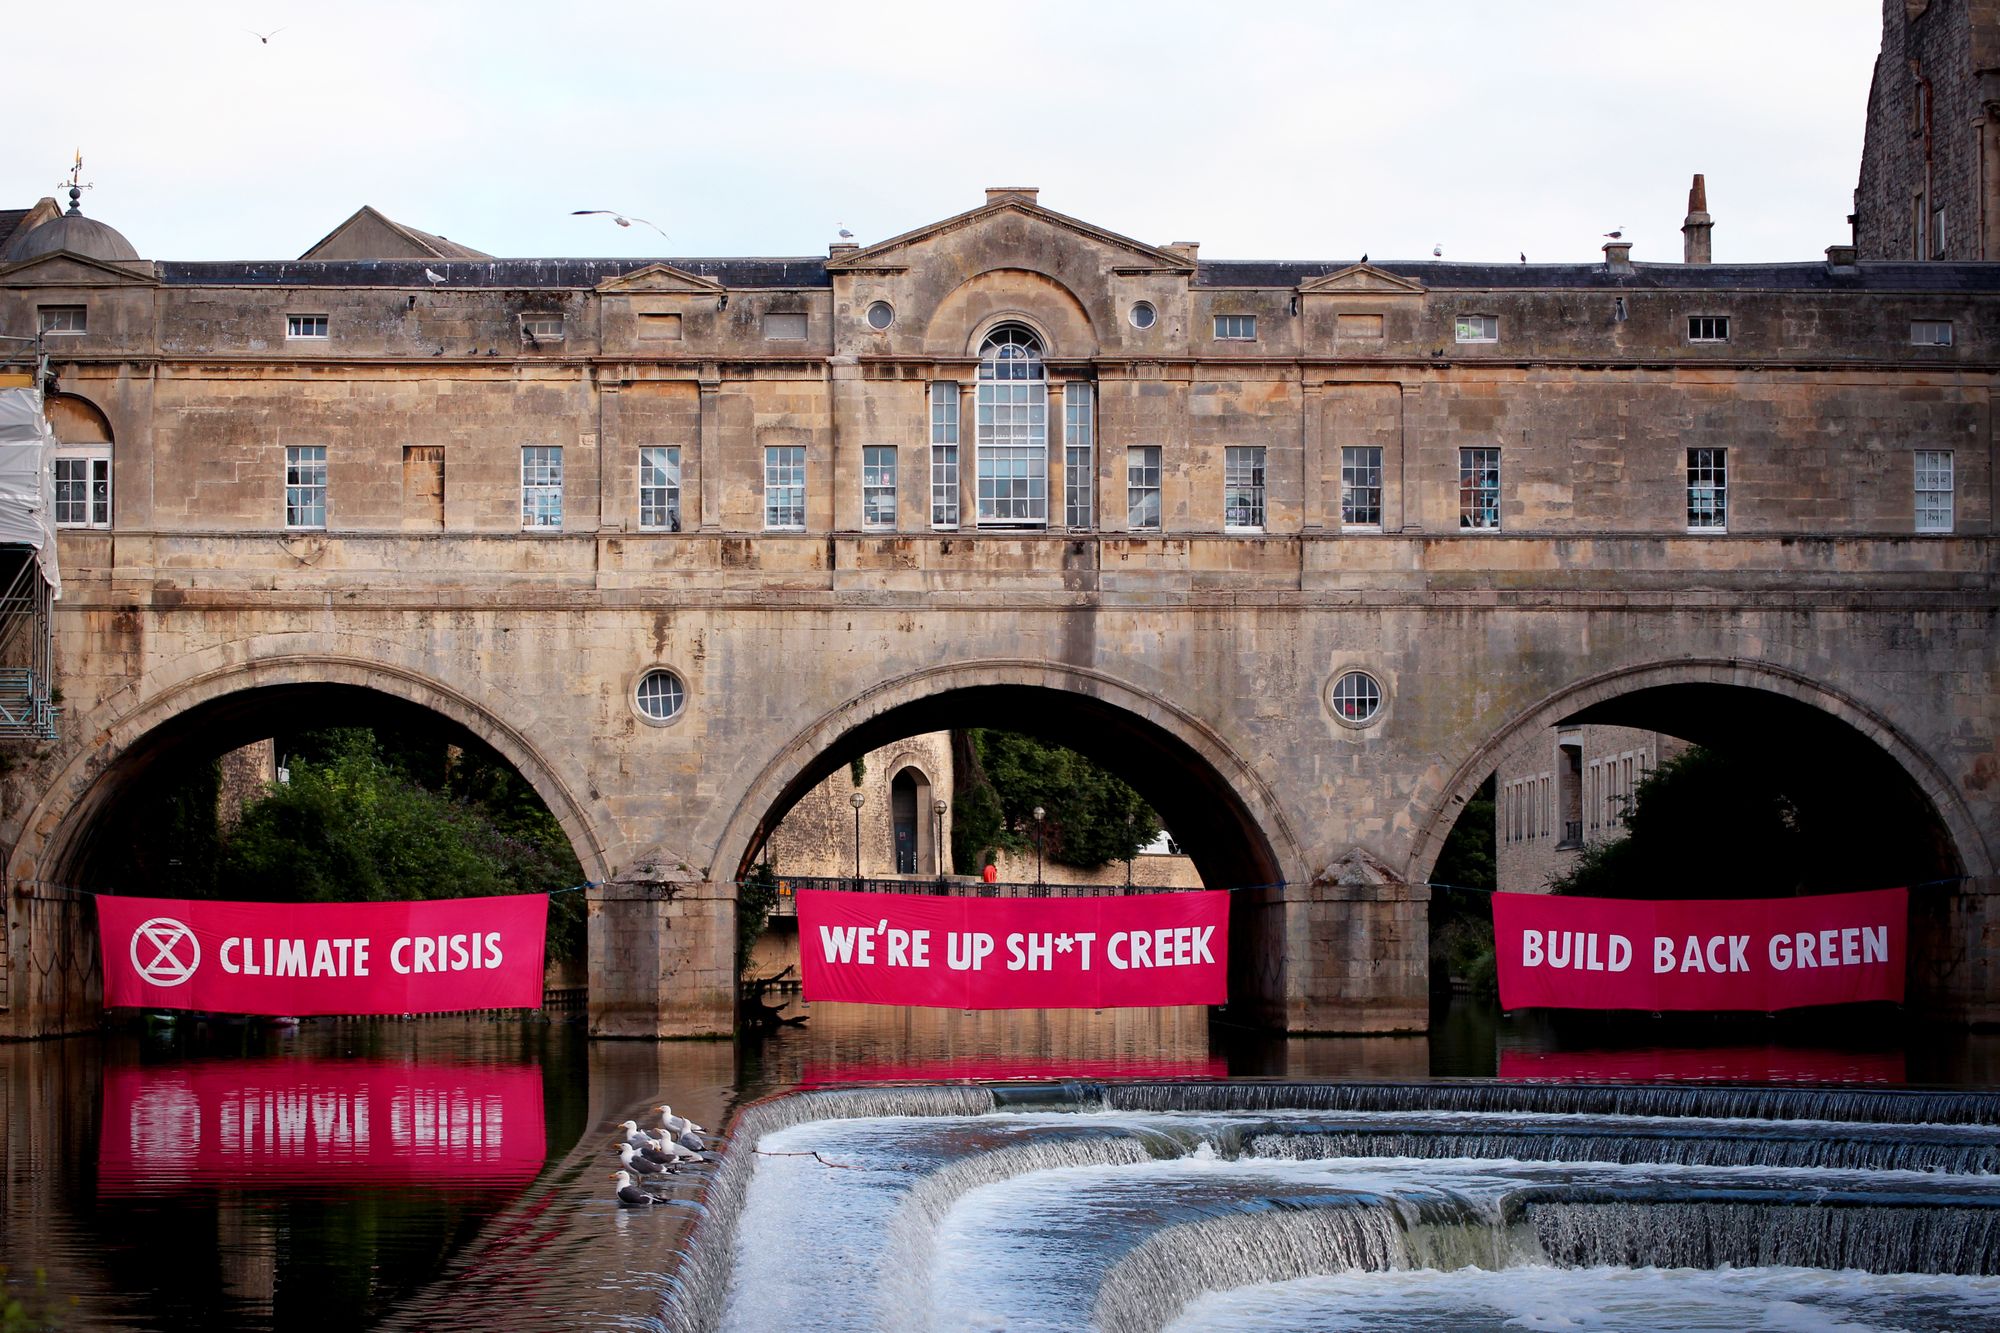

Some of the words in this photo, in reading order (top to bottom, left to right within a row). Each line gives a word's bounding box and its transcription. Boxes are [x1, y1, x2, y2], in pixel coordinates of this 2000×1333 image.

[1919, 475, 1947, 485] Atique
[220, 937, 369, 977] CLIMATE
[390, 932, 502, 974] CRISIS
[819, 919, 930, 967] WE'RE
[948, 932, 994, 970] UP
[1108, 926, 1215, 969] CREEK
[1523, 930, 1632, 972] BUILD
[1654, 936, 1750, 973] BACK
[1769, 926, 1888, 970] GREEN
